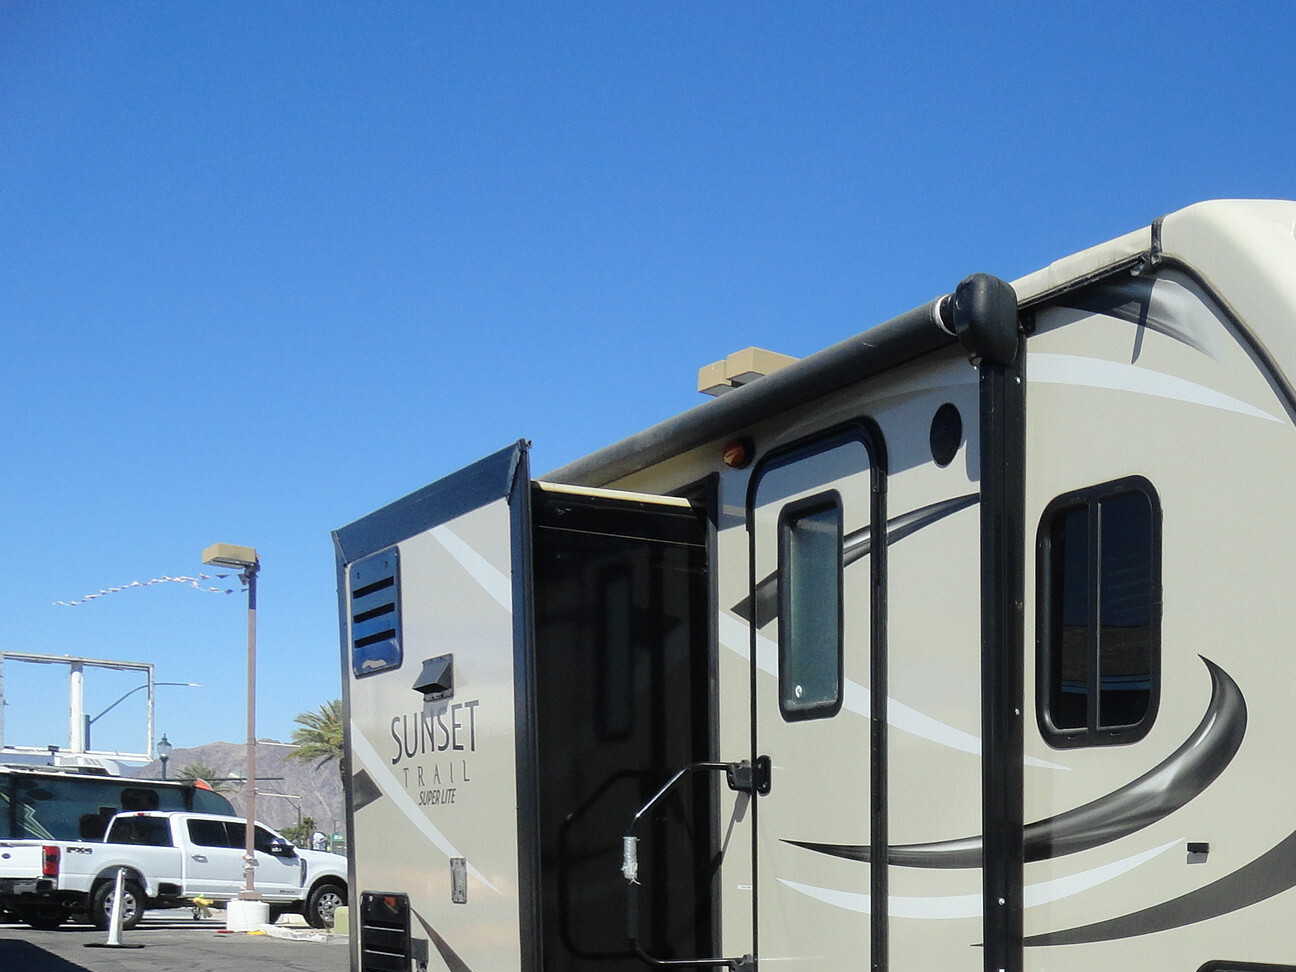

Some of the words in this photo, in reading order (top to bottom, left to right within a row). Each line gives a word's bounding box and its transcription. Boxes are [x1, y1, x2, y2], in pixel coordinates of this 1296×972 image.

[391, 700, 480, 765] SUNSET
[403, 760, 470, 788] TRAIL
[418, 790, 441, 806] SUPER
[441, 788, 456, 804] LITE
